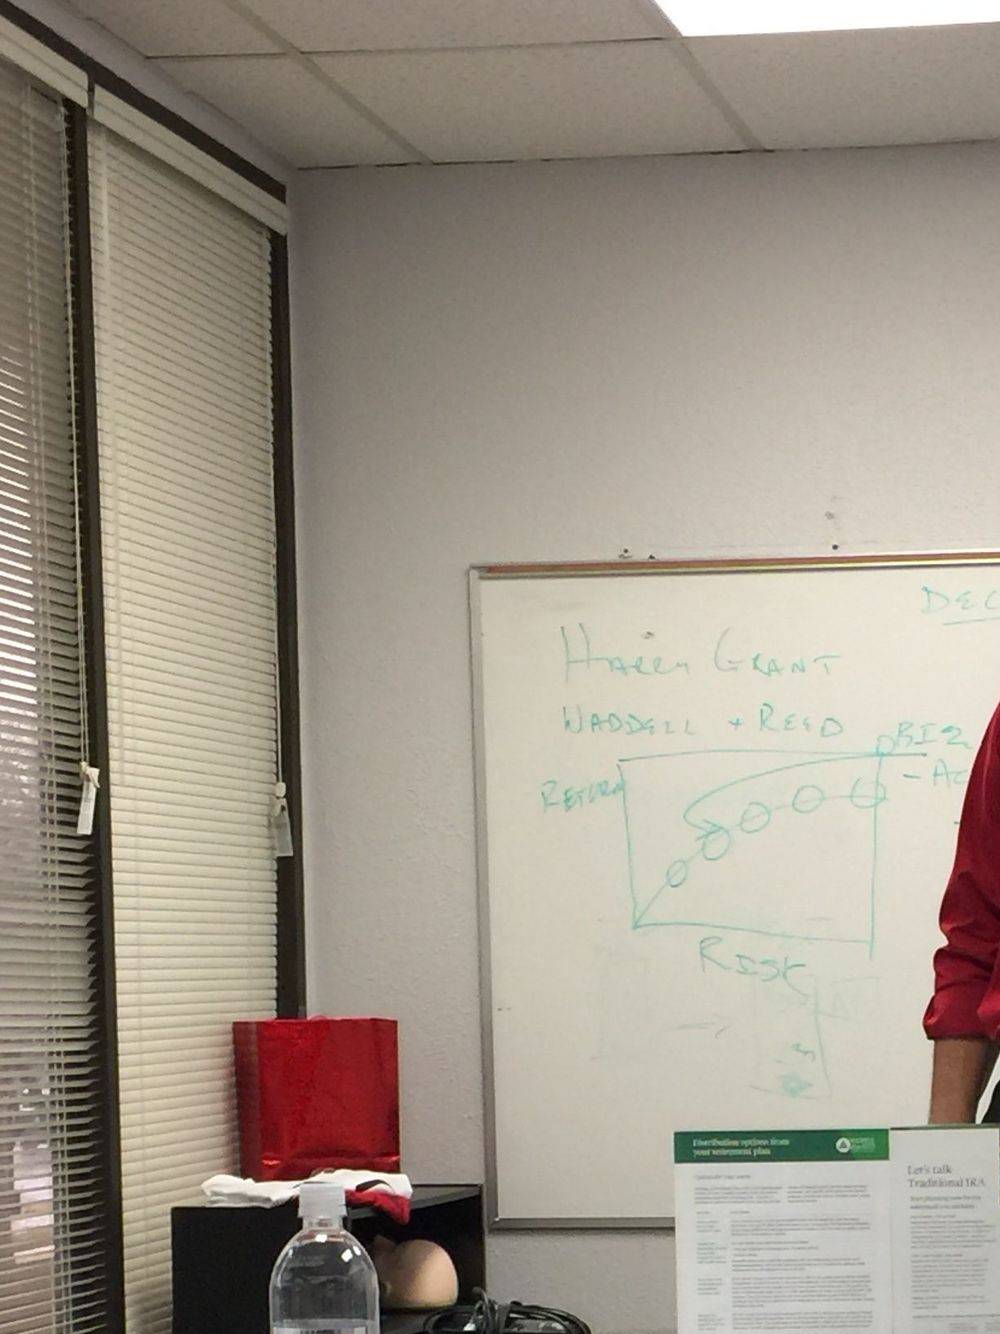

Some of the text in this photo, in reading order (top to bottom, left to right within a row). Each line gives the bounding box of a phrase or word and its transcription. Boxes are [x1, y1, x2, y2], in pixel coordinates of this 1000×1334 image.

[562, 704, 697, 735] WADDELL
[760, 702, 844, 737] REED
[699, 936, 809, 997] RISK
